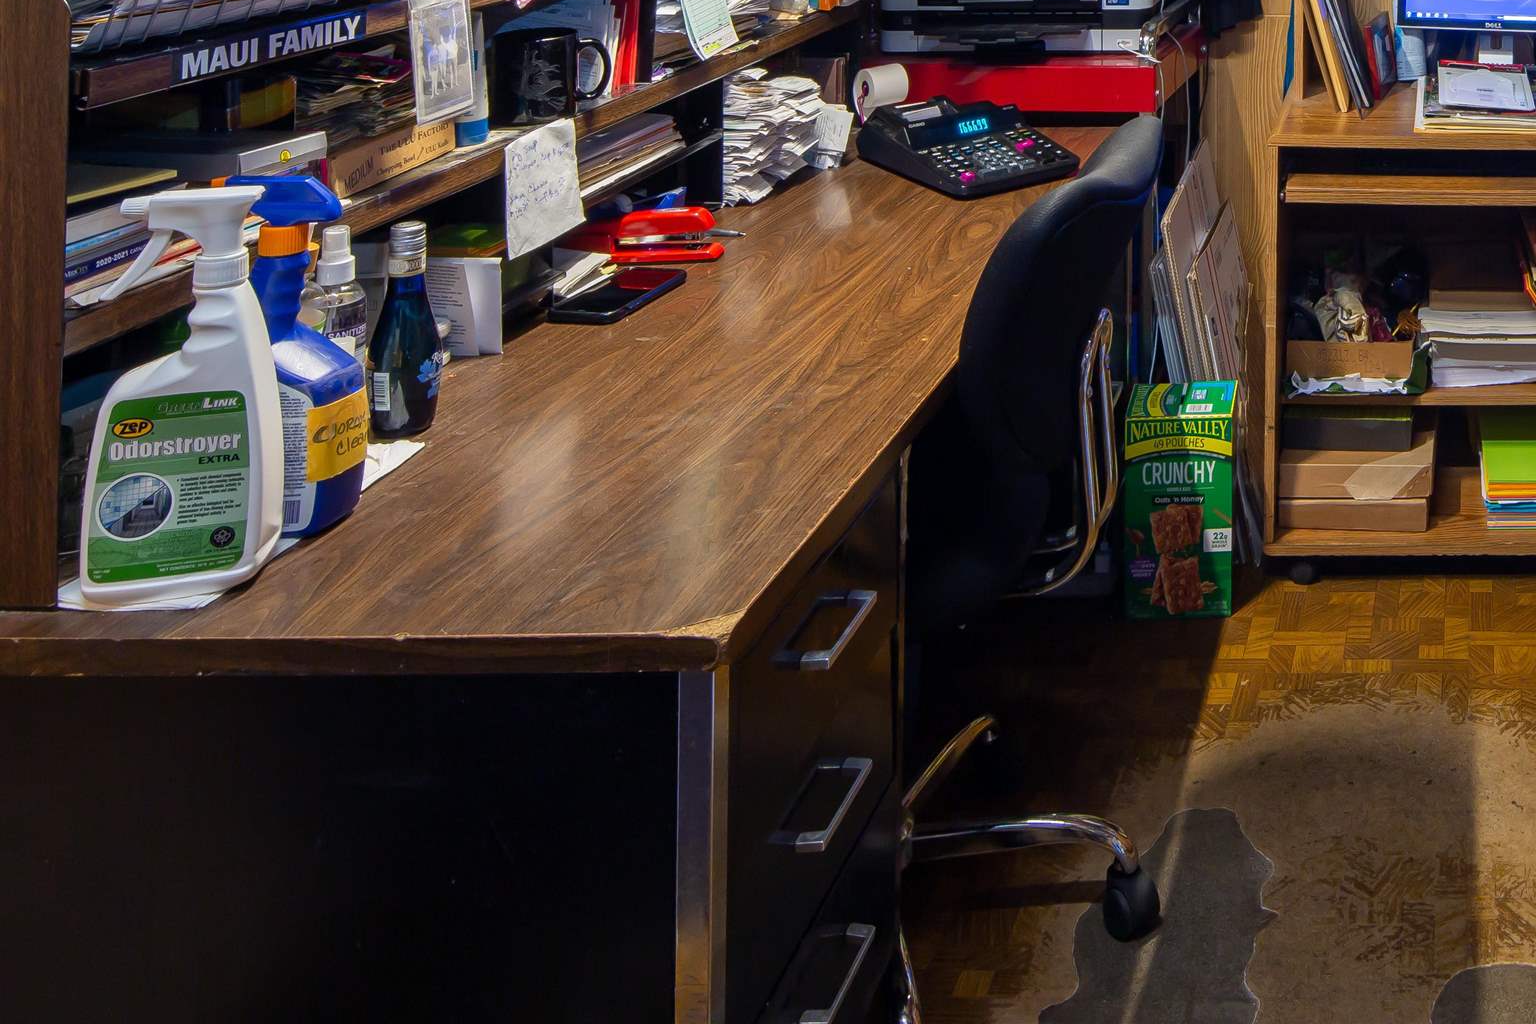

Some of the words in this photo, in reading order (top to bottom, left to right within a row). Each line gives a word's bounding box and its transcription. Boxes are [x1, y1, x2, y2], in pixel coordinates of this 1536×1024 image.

[182, 37, 259, 80] MAUI
[268, 14, 361, 60] FAMILY
[416, 121, 450, 142] FACTORY
[403, 153, 416, 166] Bowl
[344, 156, 374, 193] MEDIUM
[96, 250, 129, 268] 2020-2021
[1130, 422, 1183, 443] NATURE
[1182, 419, 1229, 440] VALLEY
[109, 433, 242, 462] Odorstroyer
[1154, 438, 1164, 449] 49
[1165, 437, 1205, 449] POUCHES
[198, 453, 240, 464] EXTRA
[1142, 460, 1216, 486] CRUNCHY
[1154, 496, 1170, 504] Oats
[1180, 496, 1204, 505] Honey
[1212, 532, 1228, 541] 22g
